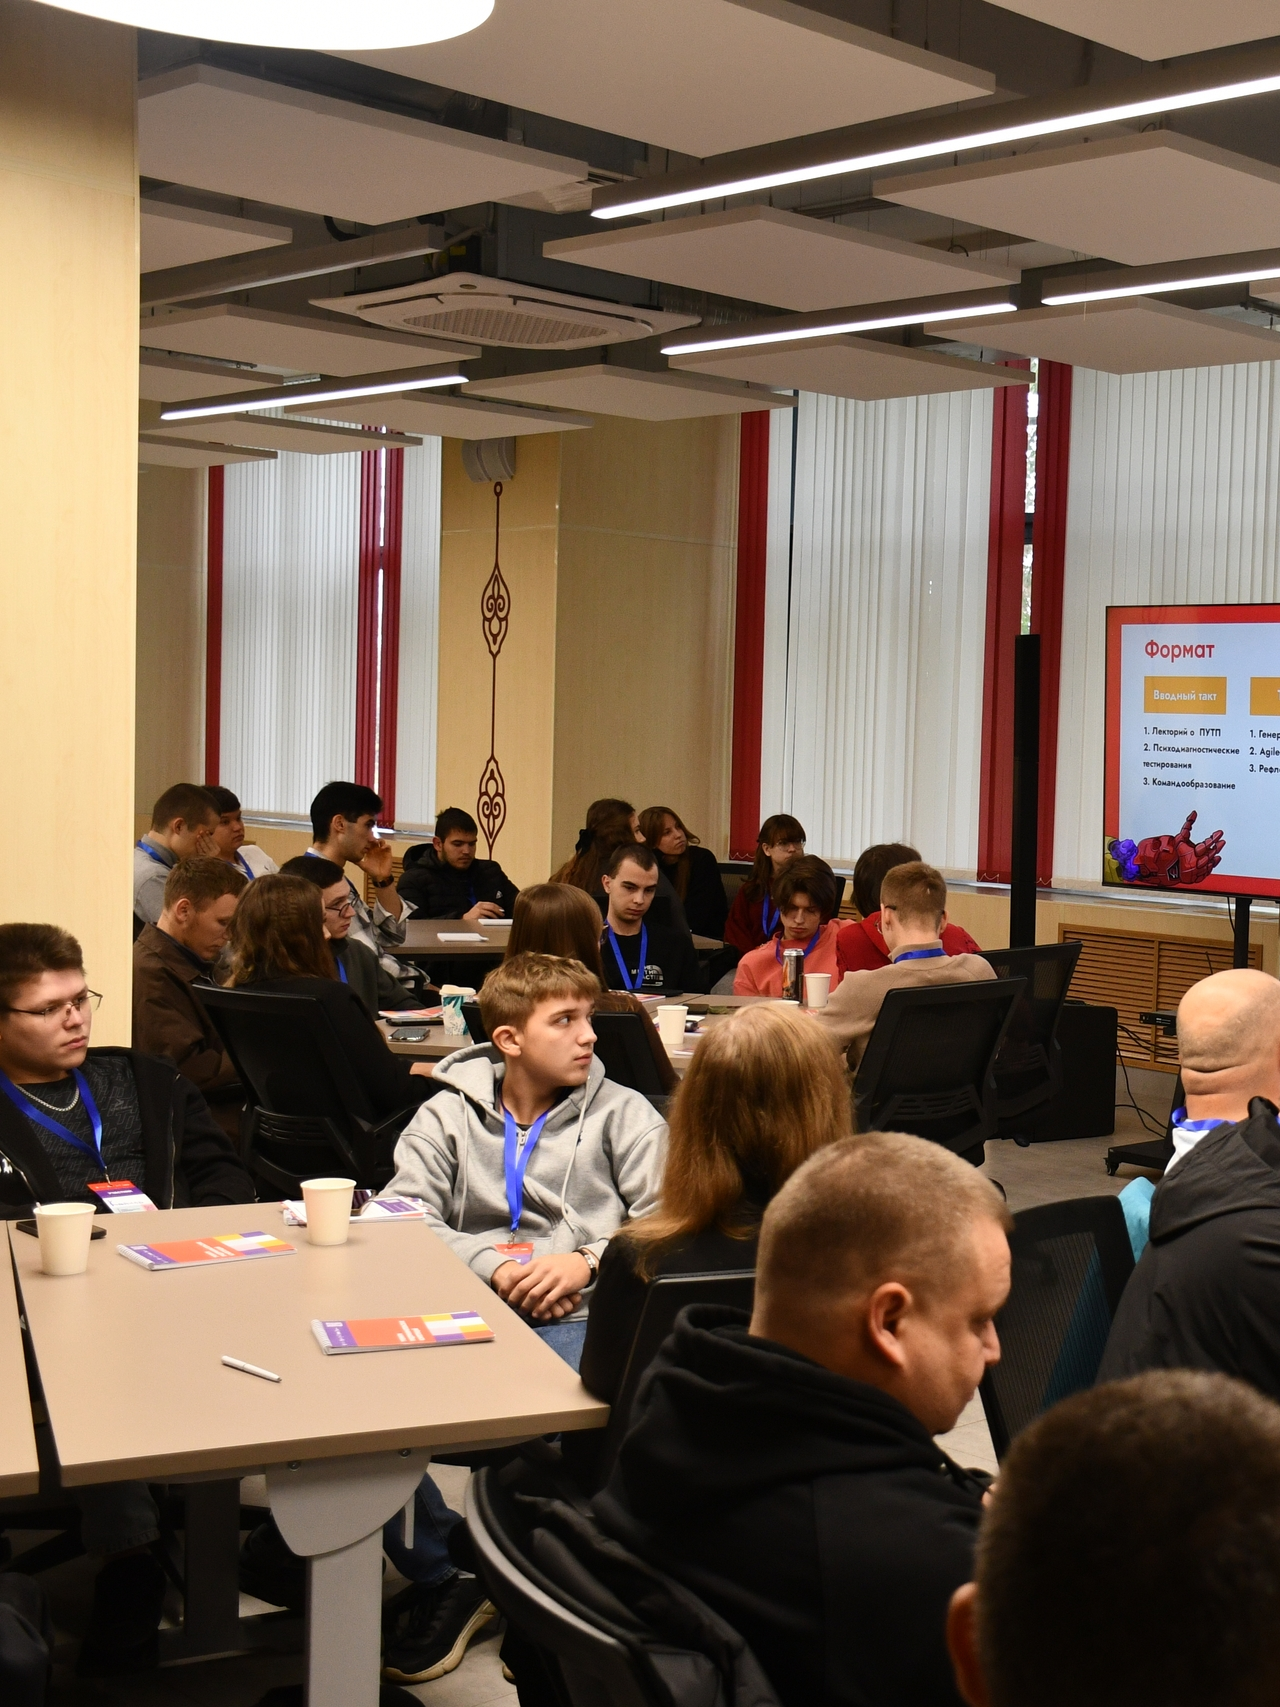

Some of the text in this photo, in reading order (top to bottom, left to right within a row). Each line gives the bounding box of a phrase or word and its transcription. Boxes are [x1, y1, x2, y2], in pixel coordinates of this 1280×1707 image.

[1145, 639, 1215, 663] Формат
[1153, 689, 1217, 701] Вводный такт
[1144, 727, 1150, 735] 1.
[1152, 727, 1188, 738] Лекторий
[1199, 728, 1221, 737] ПУТП
[1249, 730, 1256, 738] 1.
[1143, 743, 1240, 755] 2. Психодиагностические
[1249, 747, 1257, 756] 2.
[1143, 761, 1192, 770] тестирования
[1249, 764, 1256, 773] 3.
[1143, 777, 1236, 790] 3. Командообразование
